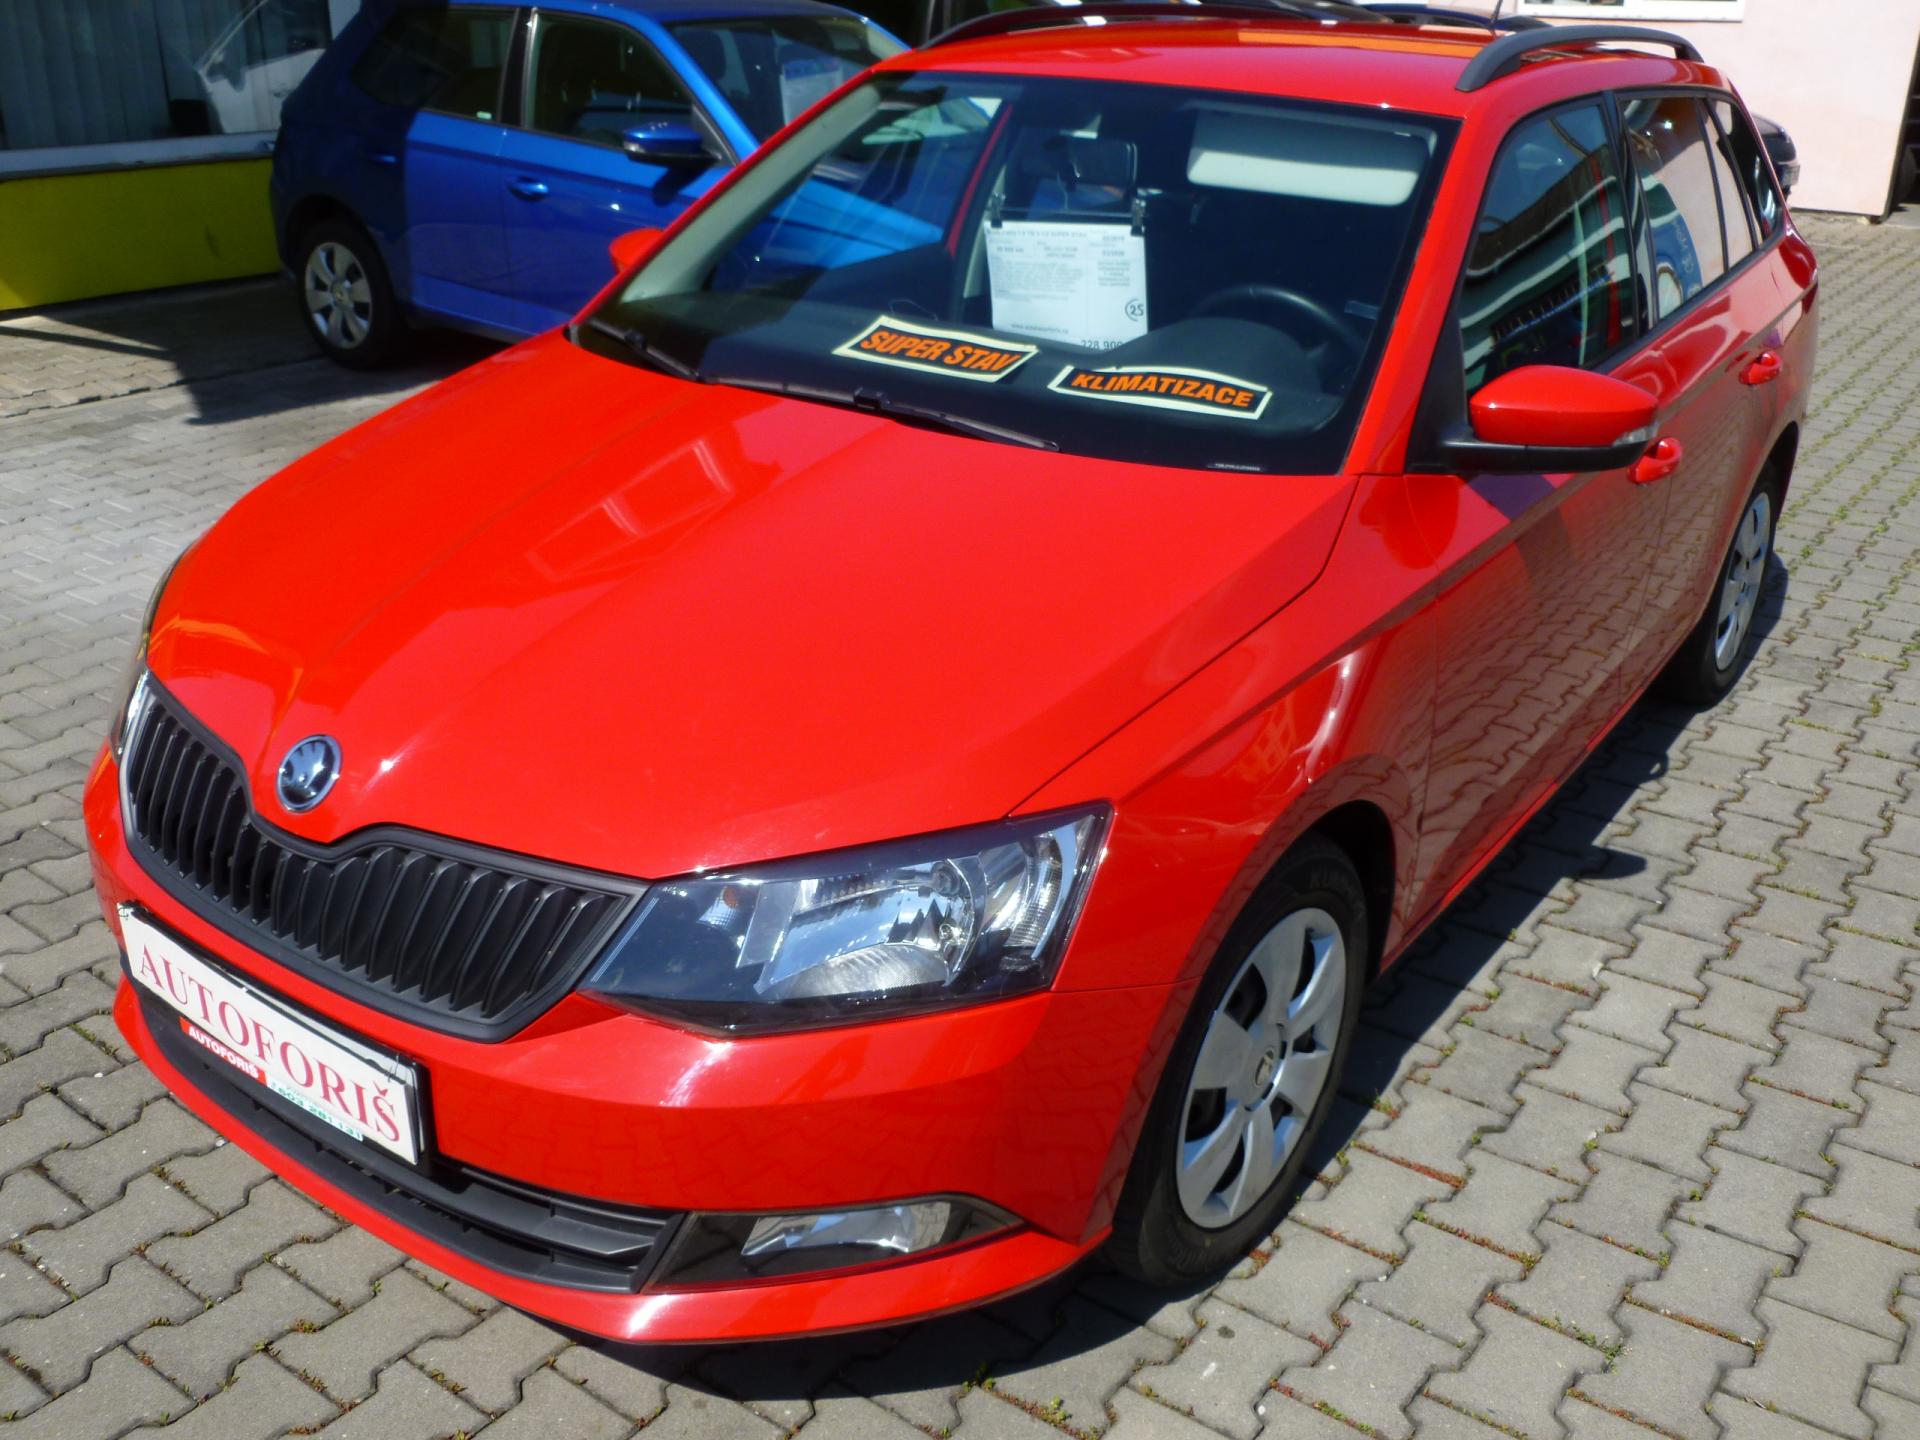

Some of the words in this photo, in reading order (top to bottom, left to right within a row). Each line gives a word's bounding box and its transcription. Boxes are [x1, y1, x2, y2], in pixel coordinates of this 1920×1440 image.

[1129, 304, 1144, 316] 25
[861, 331, 952, 360] SUPER
[942, 346, 1021, 372] STAV
[1072, 372, 1253, 407] KLIMATIZACE
[140, 945, 400, 1142] AUTOFORIŠ
[188, 1026, 260, 1079] AUTOFORIŠ
